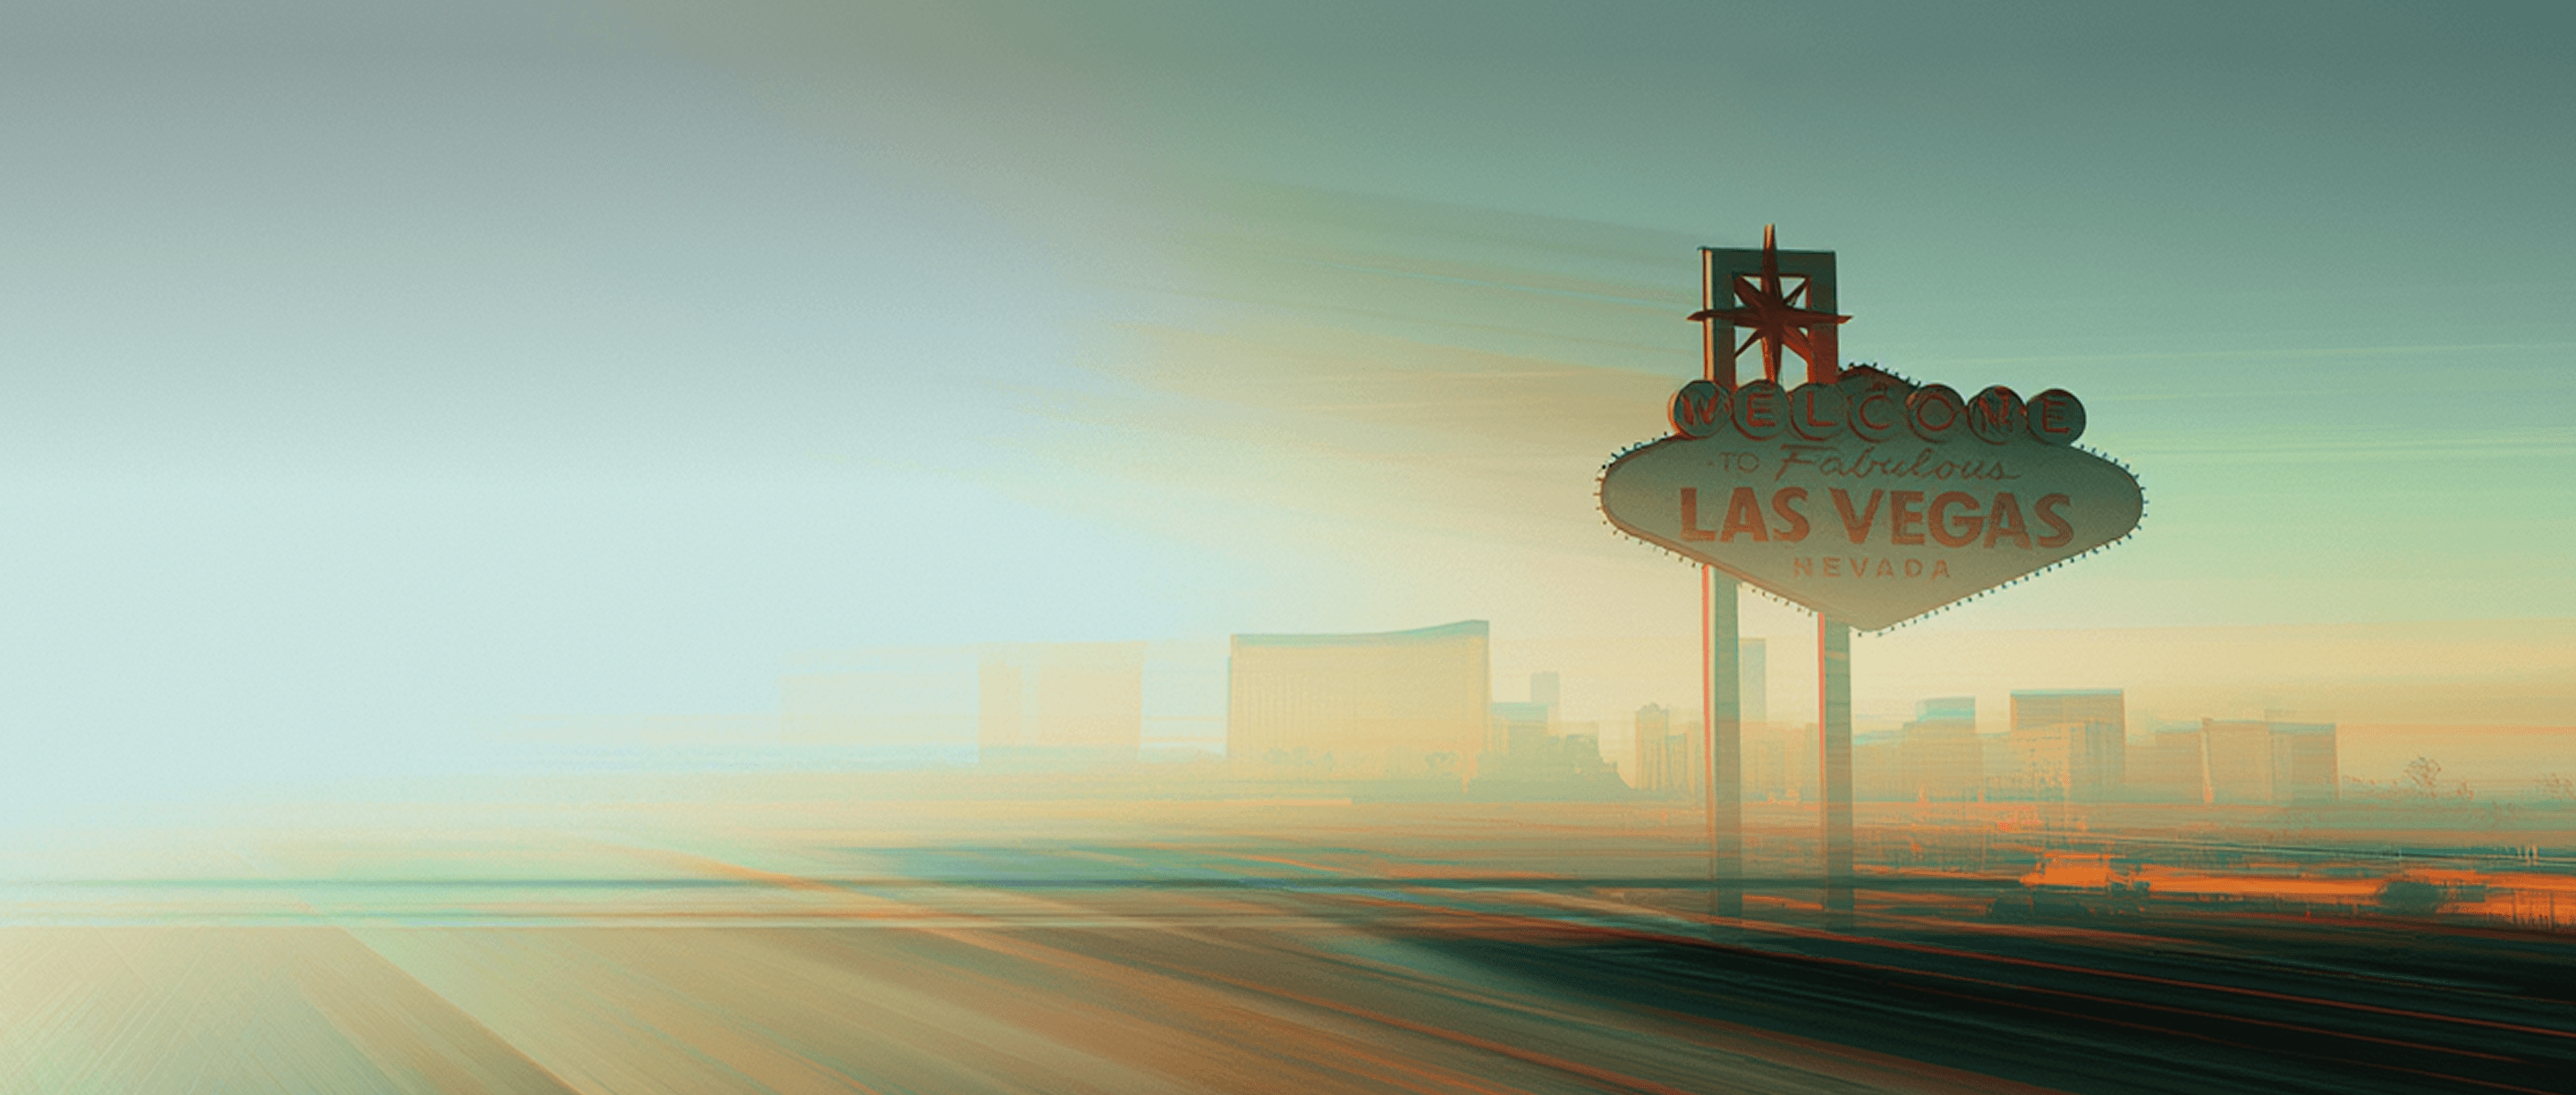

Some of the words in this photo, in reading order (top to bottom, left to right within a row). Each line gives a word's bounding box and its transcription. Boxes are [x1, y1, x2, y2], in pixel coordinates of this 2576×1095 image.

[1681, 388, 2071, 434] WELCOME
[1717, 451, 1760, 474] TO
[1774, 444, 2021, 481] Fabulous
[1679, 486, 1811, 544] LAS
[1826, 486, 2075, 550] VEGAS
[1793, 556, 1951, 581] NEVADA
